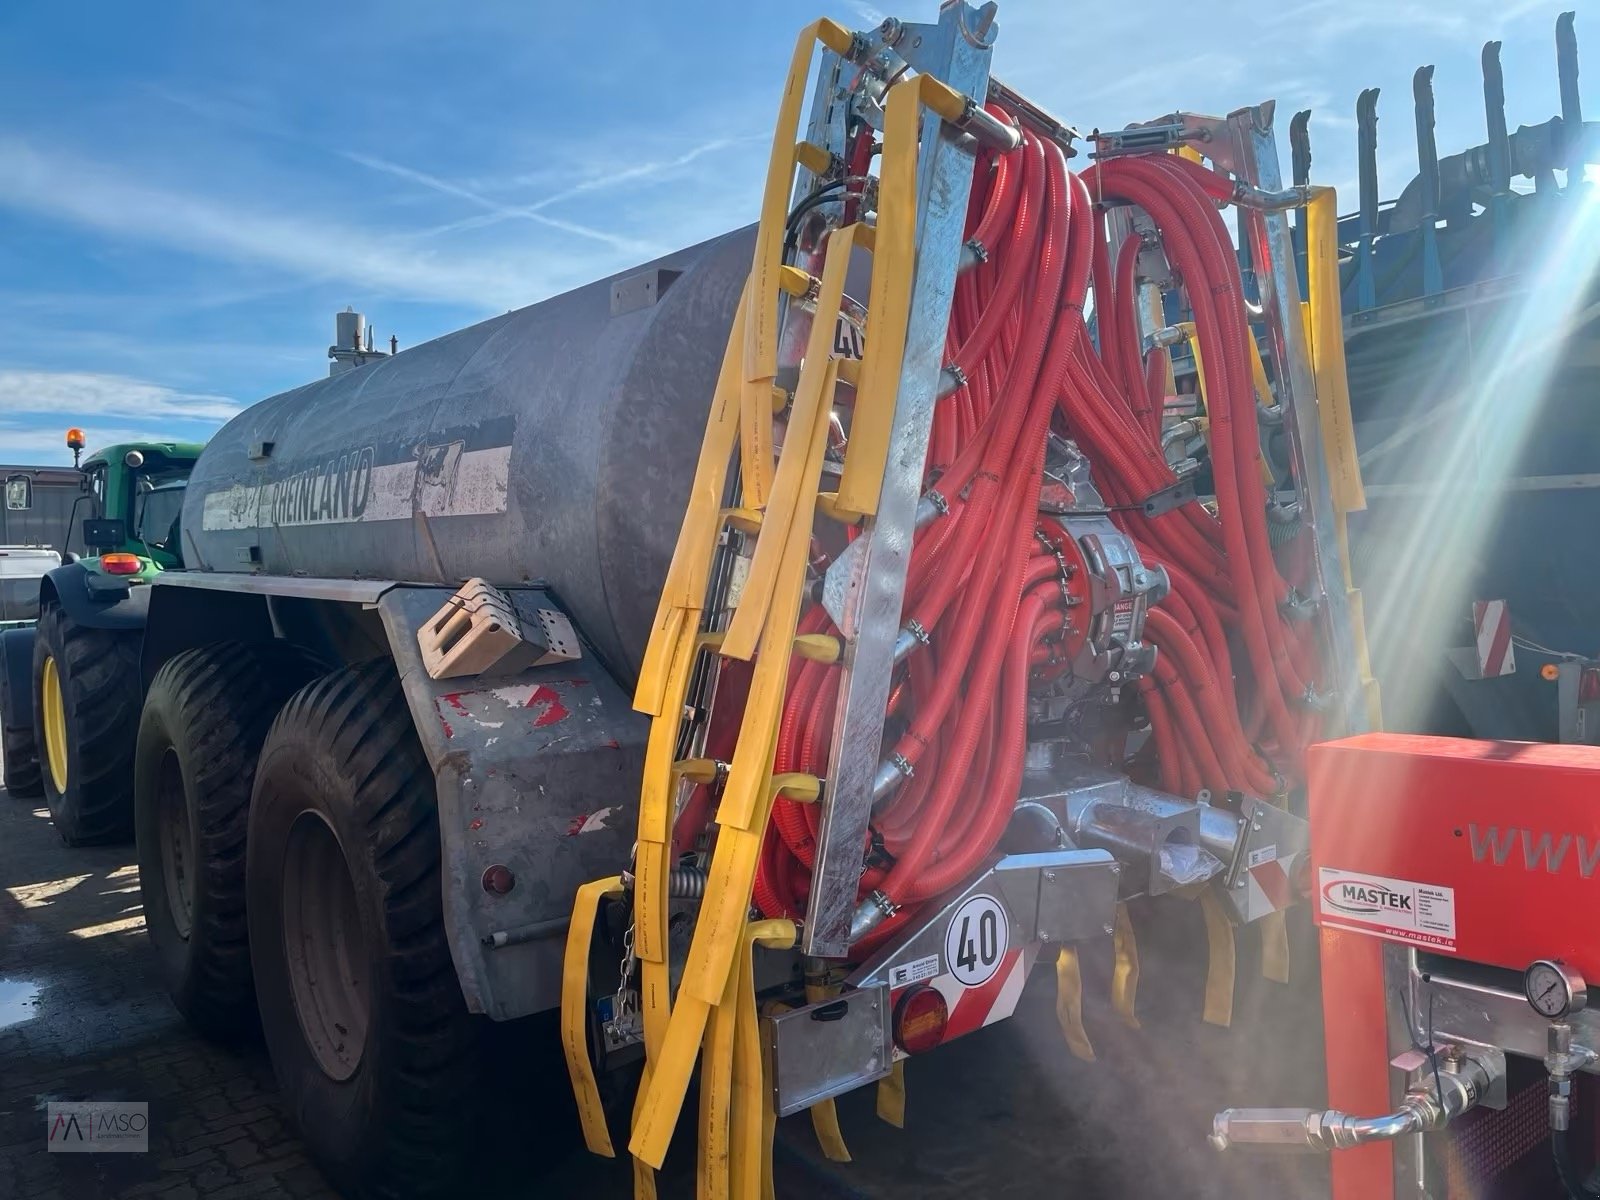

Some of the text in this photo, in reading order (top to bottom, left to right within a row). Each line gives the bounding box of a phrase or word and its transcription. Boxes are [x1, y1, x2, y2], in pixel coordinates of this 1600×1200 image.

[271, 446, 374, 524] RHEINLAND
[1342, 885, 1412, 910] MASTEK
[957, 909, 998, 973] 40
[1385, 928, 1454, 946] www.mastek.ie
